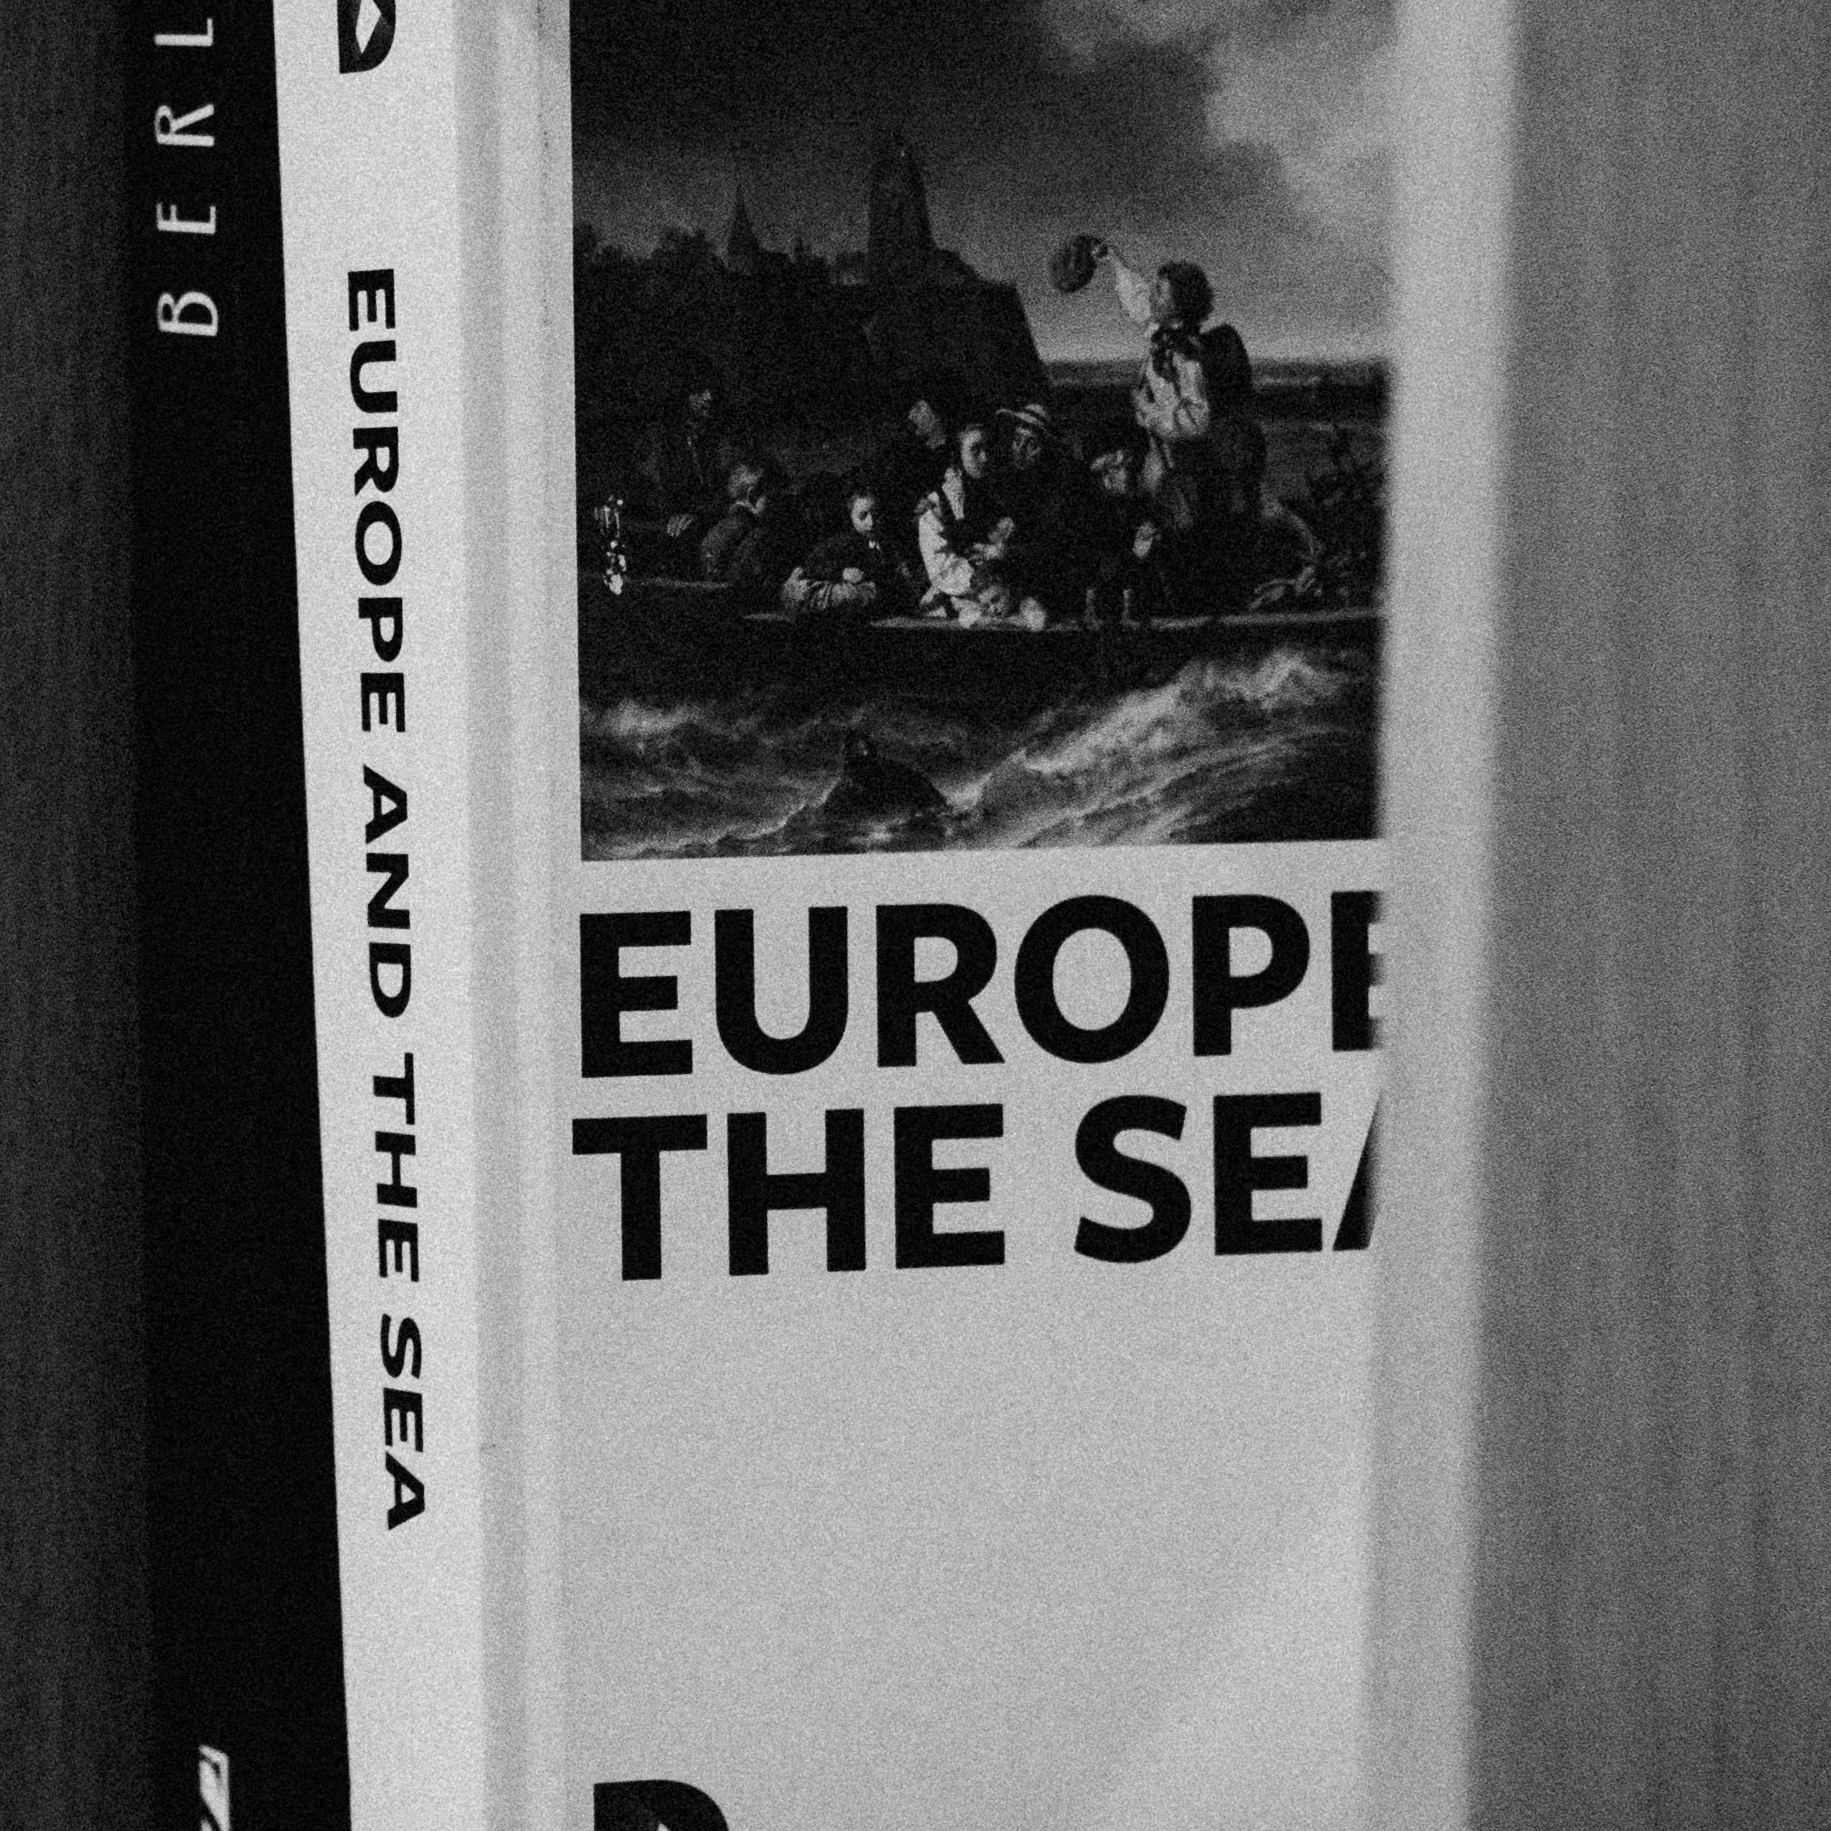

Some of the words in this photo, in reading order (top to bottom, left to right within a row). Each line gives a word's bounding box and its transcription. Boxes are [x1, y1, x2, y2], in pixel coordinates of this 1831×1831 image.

[347, 267, 407, 733] EUROPE
[362, 766, 413, 1019] AND
[373, 1052, 421, 1283] THE
[572, 1102, 1006, 1281] THE
[380, 1314, 427, 1530] SEA
